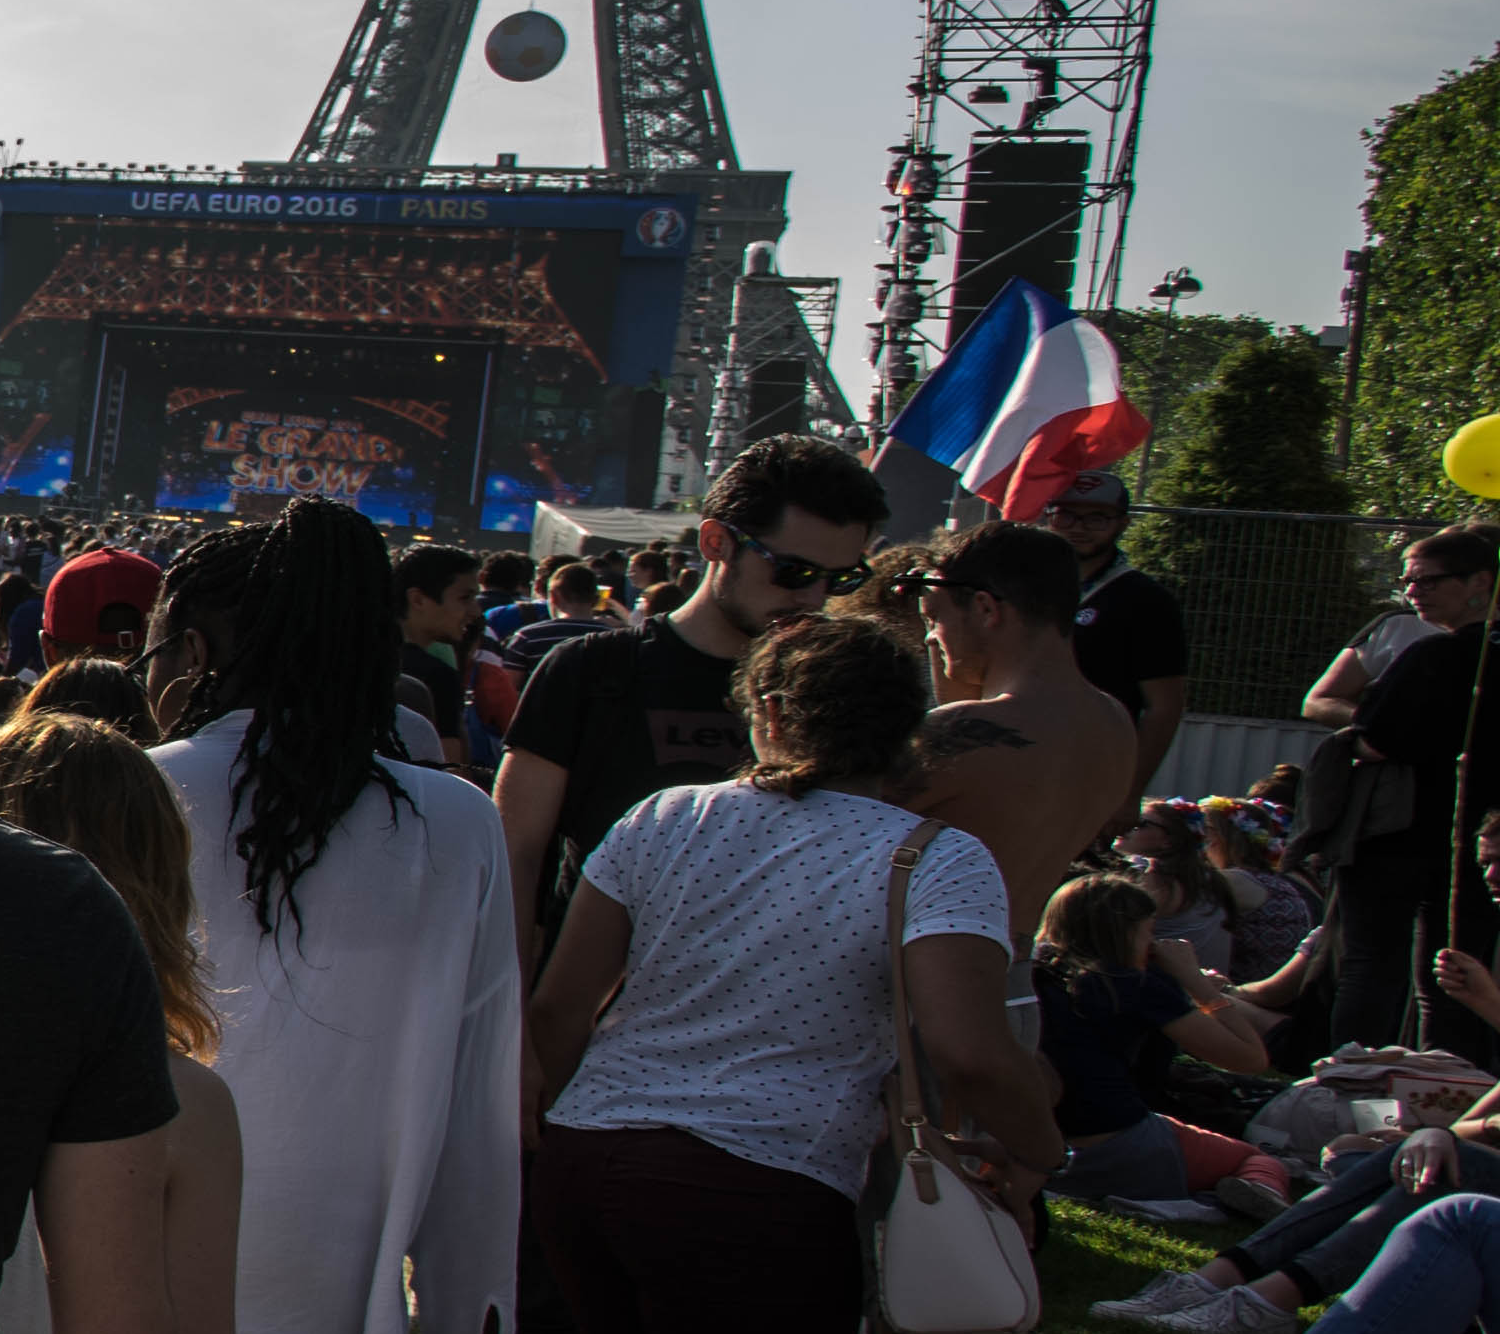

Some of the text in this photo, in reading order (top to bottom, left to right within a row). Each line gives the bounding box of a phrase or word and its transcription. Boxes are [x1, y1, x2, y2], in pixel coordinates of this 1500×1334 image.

[130, 191, 489, 219] UEFA EURO 2016 PARIS
[202, 419, 251, 452] LE
[257, 424, 399, 463] GRAND
[229, 452, 377, 495] SHOW
[666, 724, 748, 749] Lev
